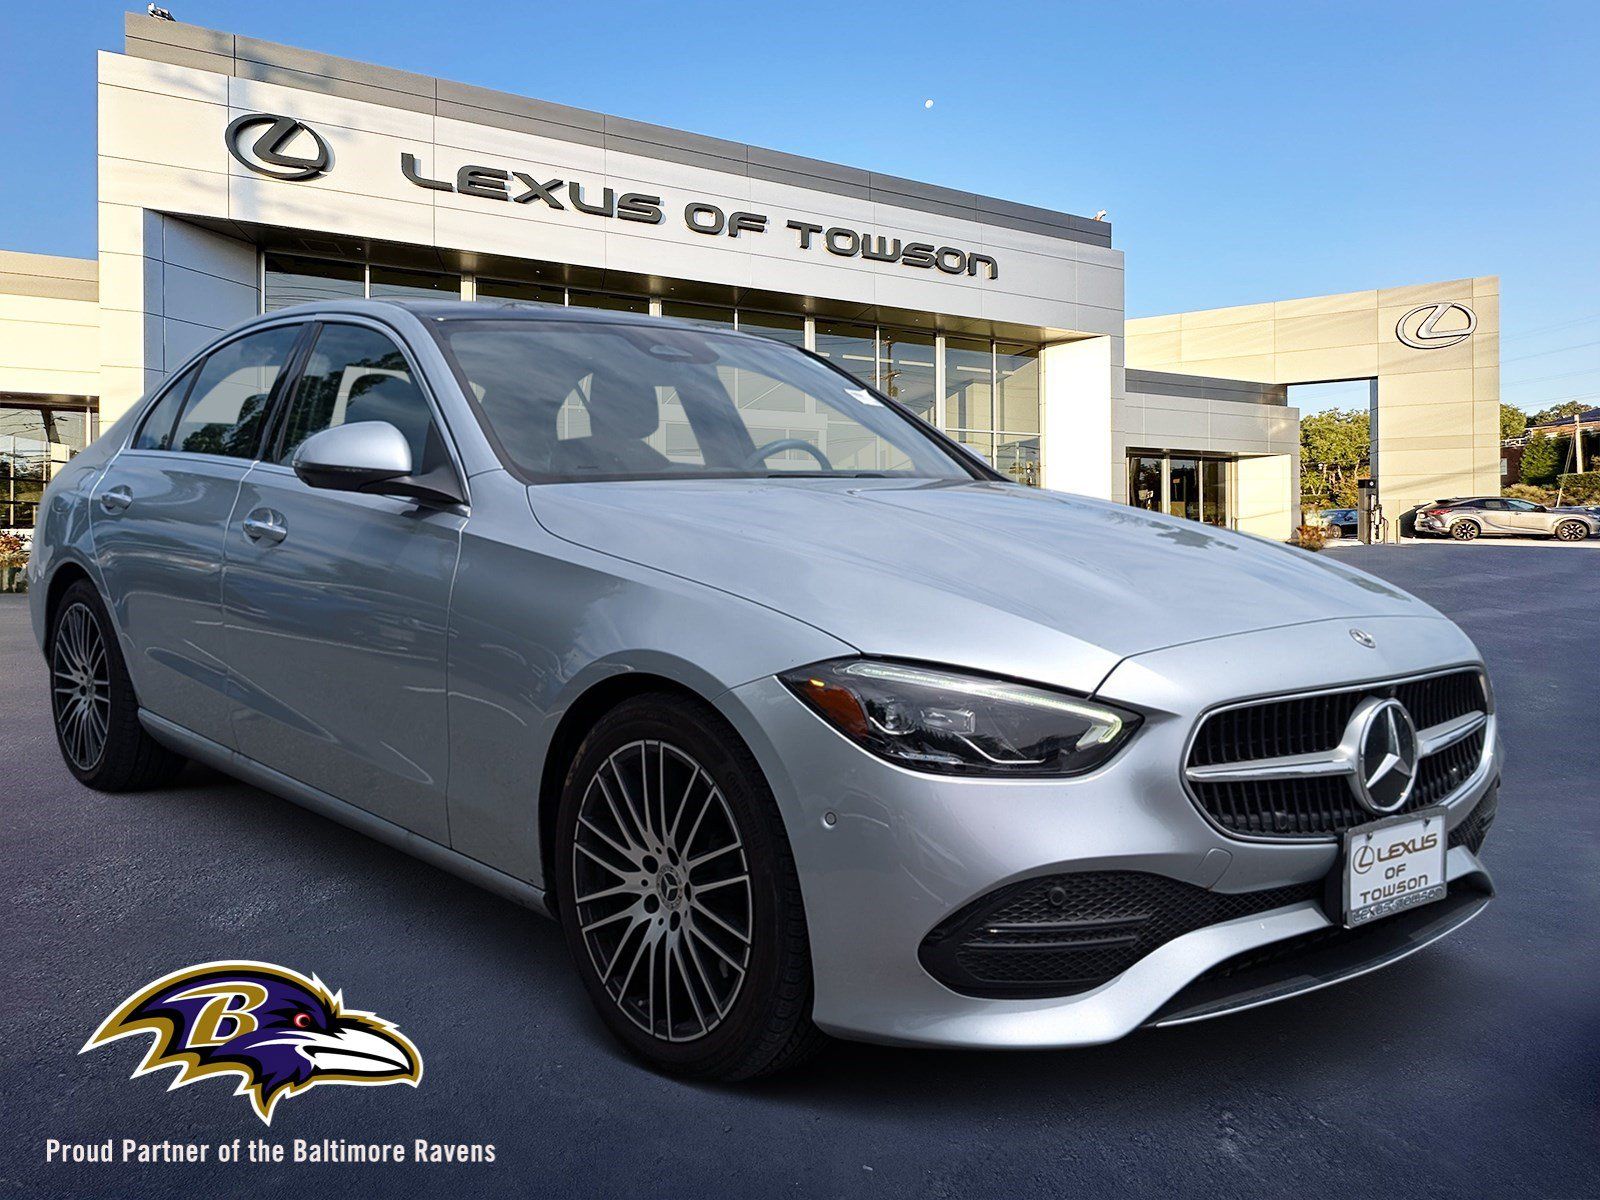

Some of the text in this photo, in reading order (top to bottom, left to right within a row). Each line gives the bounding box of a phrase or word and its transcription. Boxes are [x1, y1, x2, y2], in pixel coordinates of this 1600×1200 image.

[401, 152, 999, 280] LEXUS OF TOWSON
[1377, 833, 1438, 862] LEXUS
[1384, 863, 1407, 880] OF
[1360, 874, 1428, 904] TOWSON
